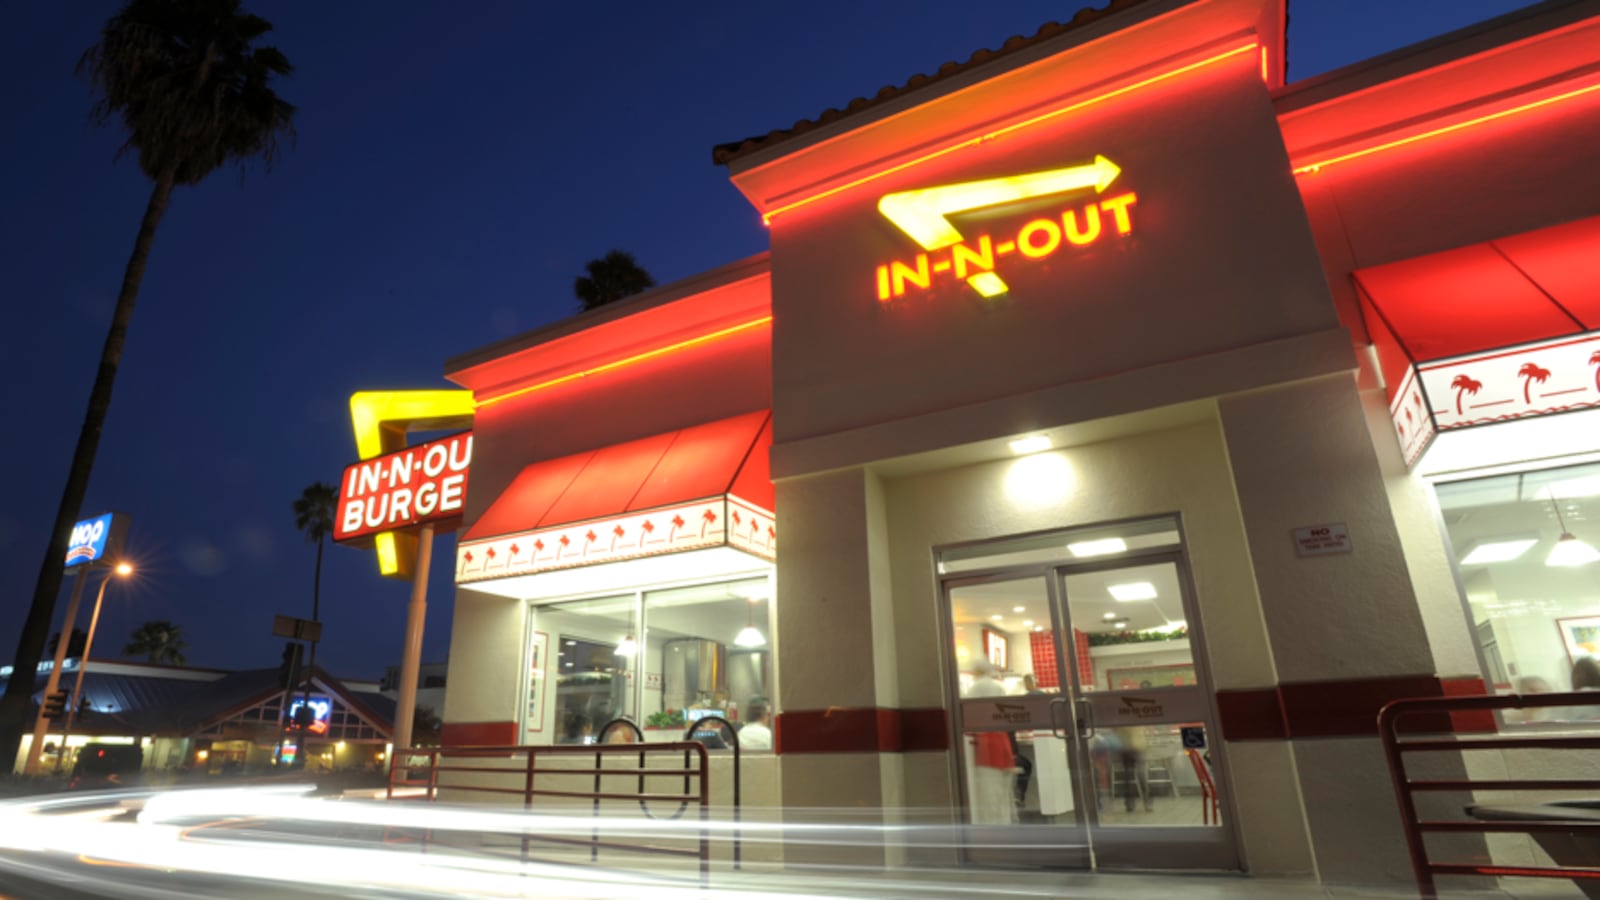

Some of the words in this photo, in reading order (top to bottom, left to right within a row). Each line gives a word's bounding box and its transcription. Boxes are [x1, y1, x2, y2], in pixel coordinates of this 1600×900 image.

[877, 192, 1137, 300] IN-N-OUT
[347, 436, 473, 498] IN-N-OU
[342, 474, 464, 533] BURGE
[1311, 528, 1330, 537] NO
